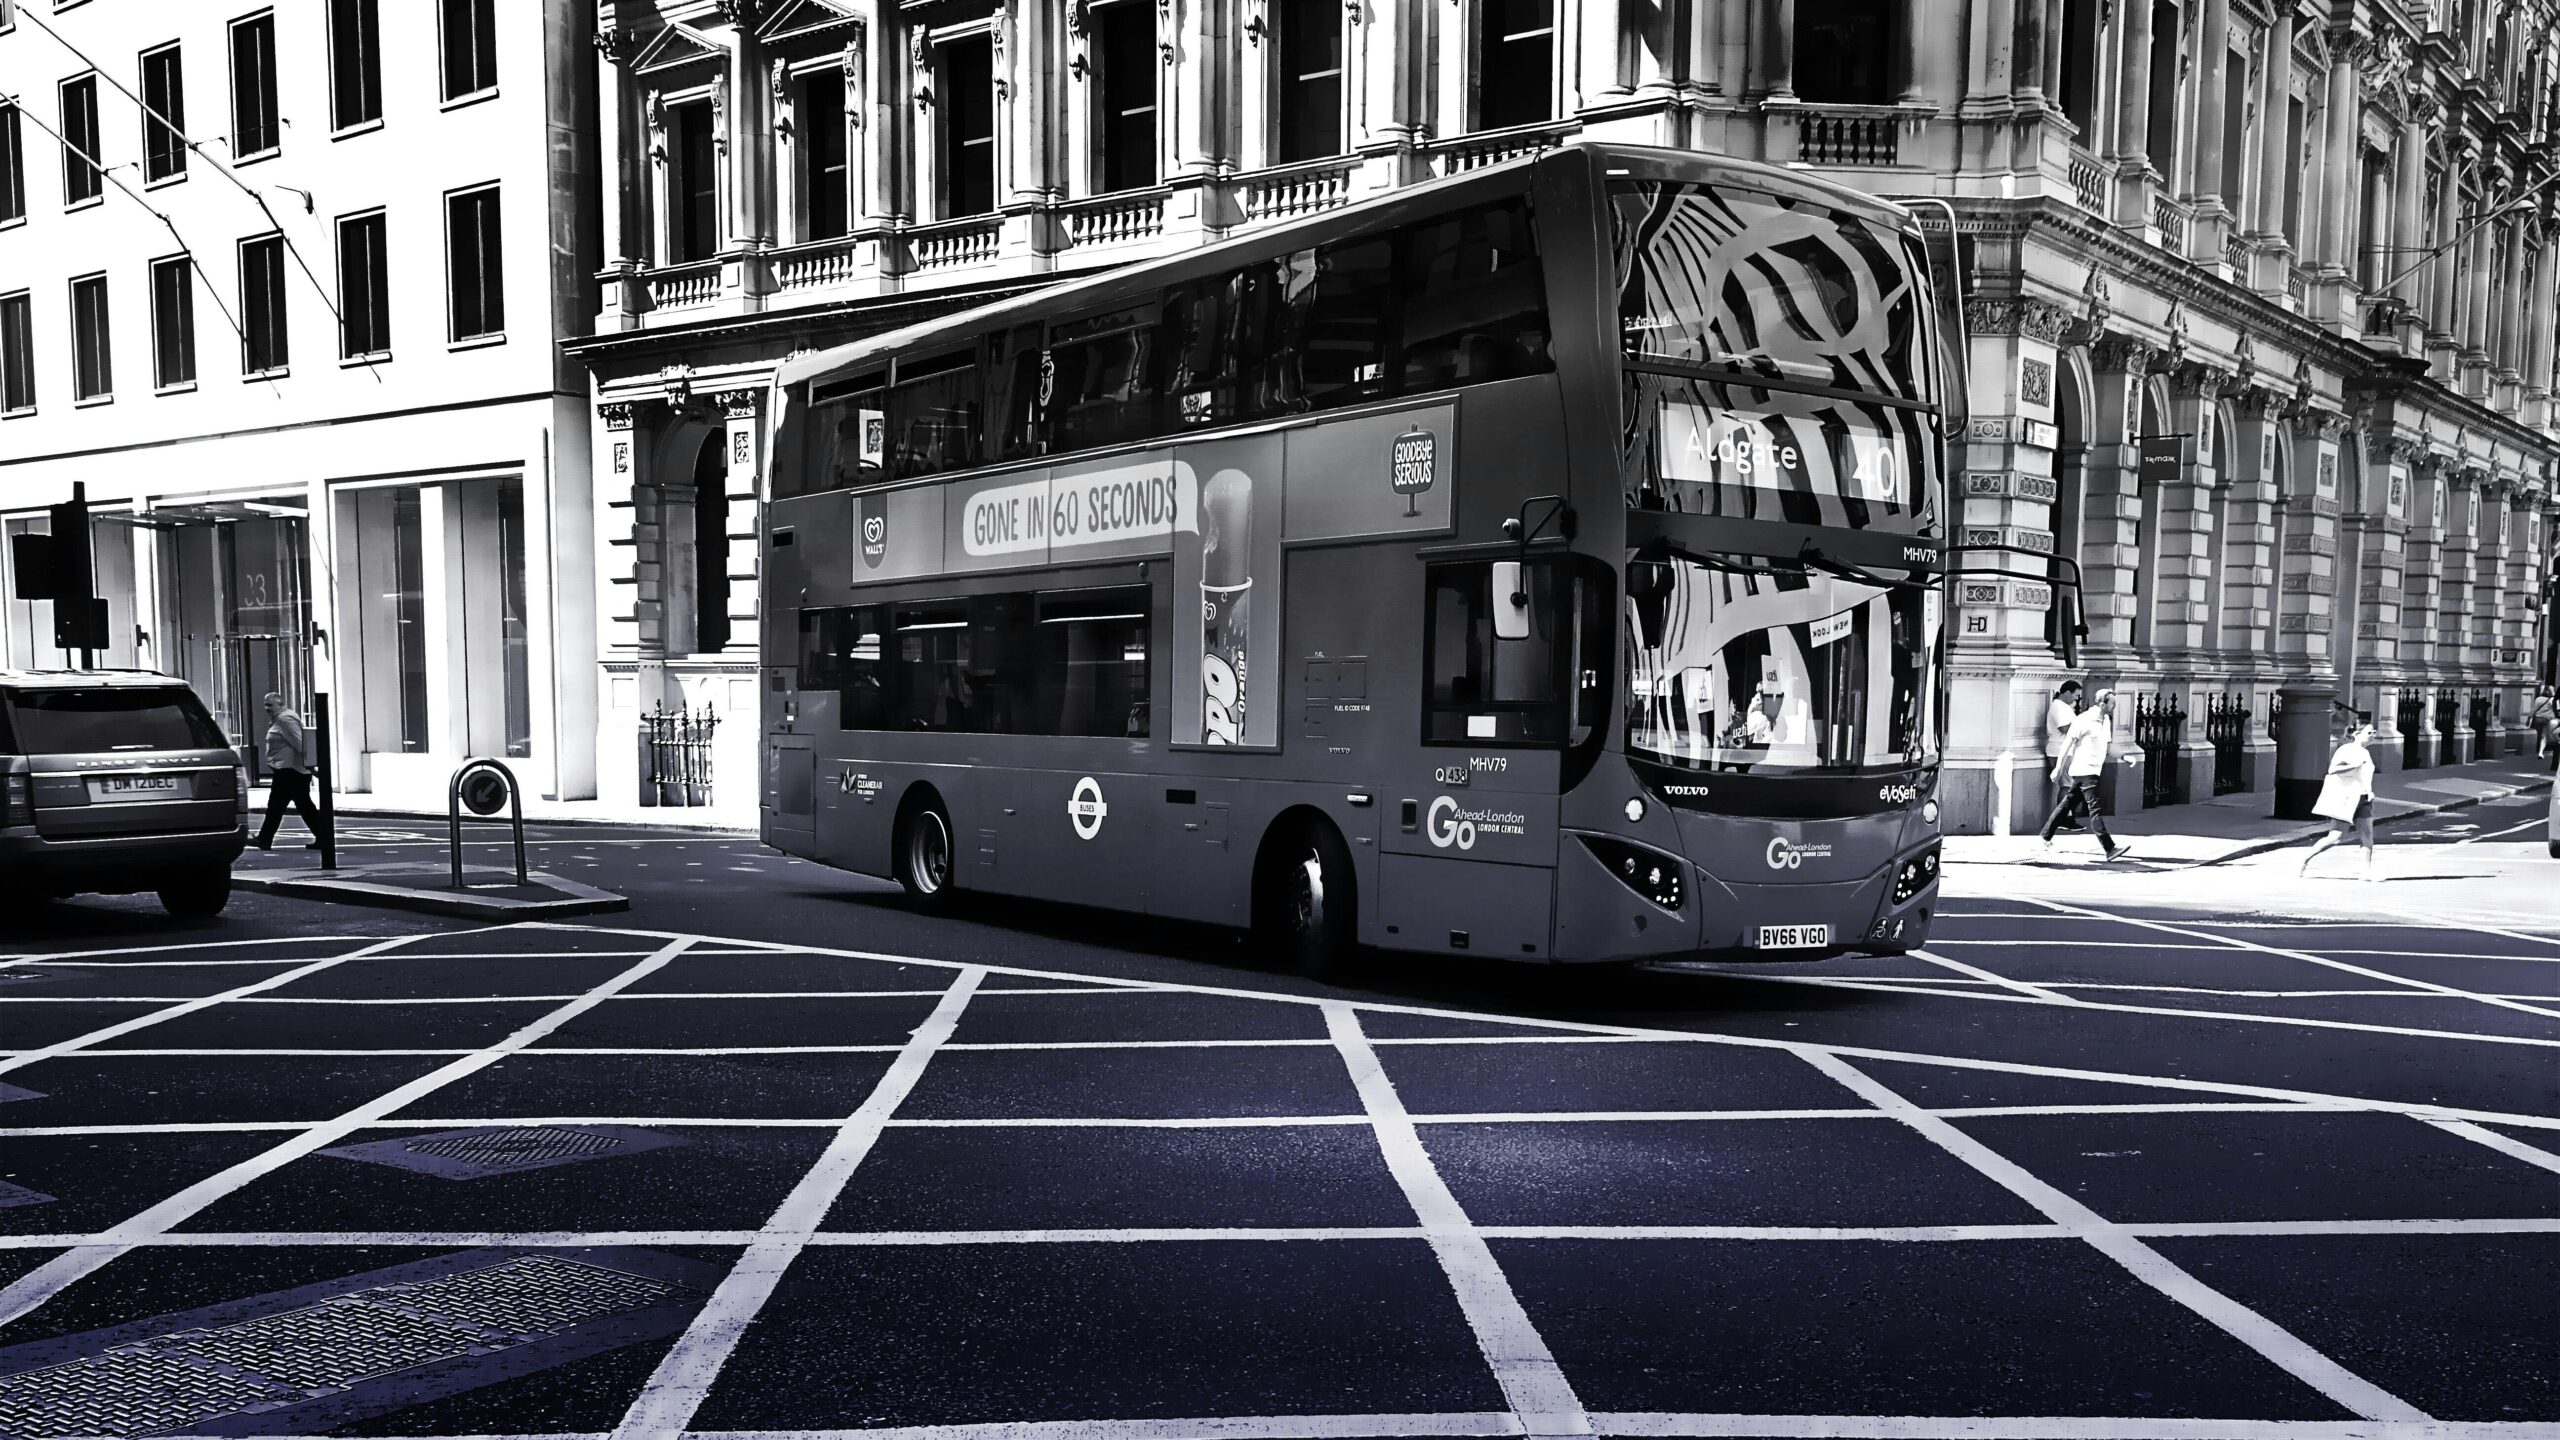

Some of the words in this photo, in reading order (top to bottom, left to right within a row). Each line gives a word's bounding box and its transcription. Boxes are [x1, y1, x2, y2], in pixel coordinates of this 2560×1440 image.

[1686, 427, 1797, 475] Aldgate
[1852, 447, 1895, 499] 40
[975, 498, 1019, 546] GONE
[1027, 495, 1044, 538] IN
[1053, 490, 1079, 537] 60
[1088, 475, 1177, 533] SECONDS
[1903, 546, 1937, 563] MHV79
[1237, 650, 1246, 713] Orange
[1469, 757, 1507, 772] MHV79
[1435, 768, 1445, 782] Q
[1448, 768, 1467, 782] 438
[1664, 785, 1709, 796] VOLVO
[1879, 783, 1917, 803] eVoSeti
[1080, 804, 1095, 812] BUSES
[1453, 808, 1525, 824] Ahead-London
[1427, 795, 1476, 850] Go
[1477, 823, 1500, 833] LONDON
[1501, 825, 1524, 834] CENTRAL
[1766, 837, 1801, 869] Go
[1762, 928, 1797, 946] BV66
[1800, 927, 1826, 944] VGO
